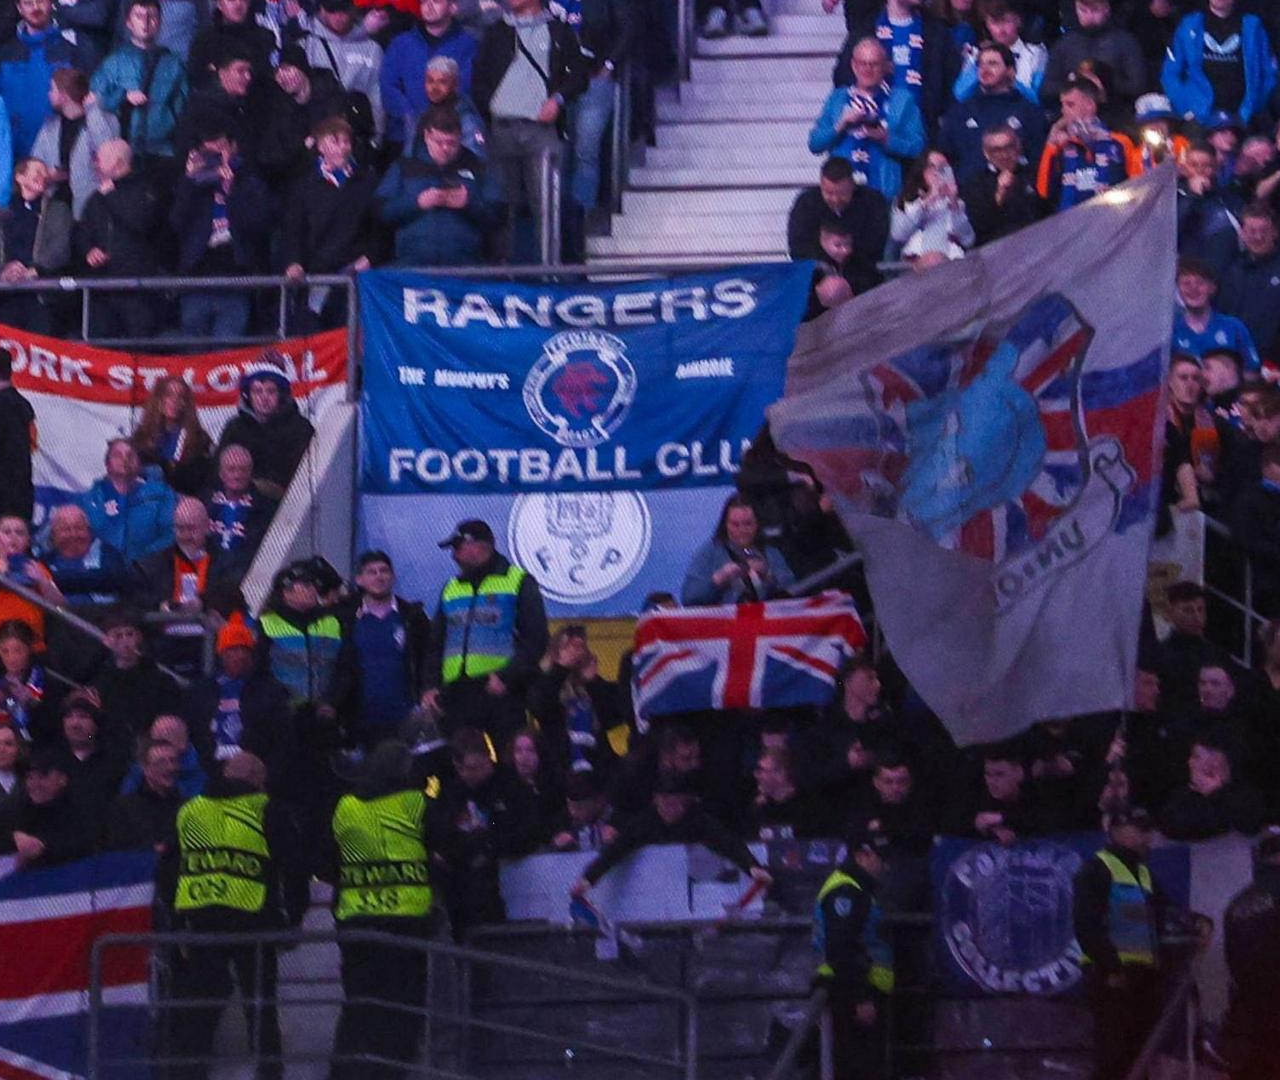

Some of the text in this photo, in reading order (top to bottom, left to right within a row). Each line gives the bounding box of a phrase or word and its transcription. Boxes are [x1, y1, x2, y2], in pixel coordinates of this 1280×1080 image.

[403, 278, 758, 328] RANGERS
[0, 336, 93, 386] ORK
[181, 349, 329, 392] LOL
[389, 438, 752, 483] FOOTBALL CLU
